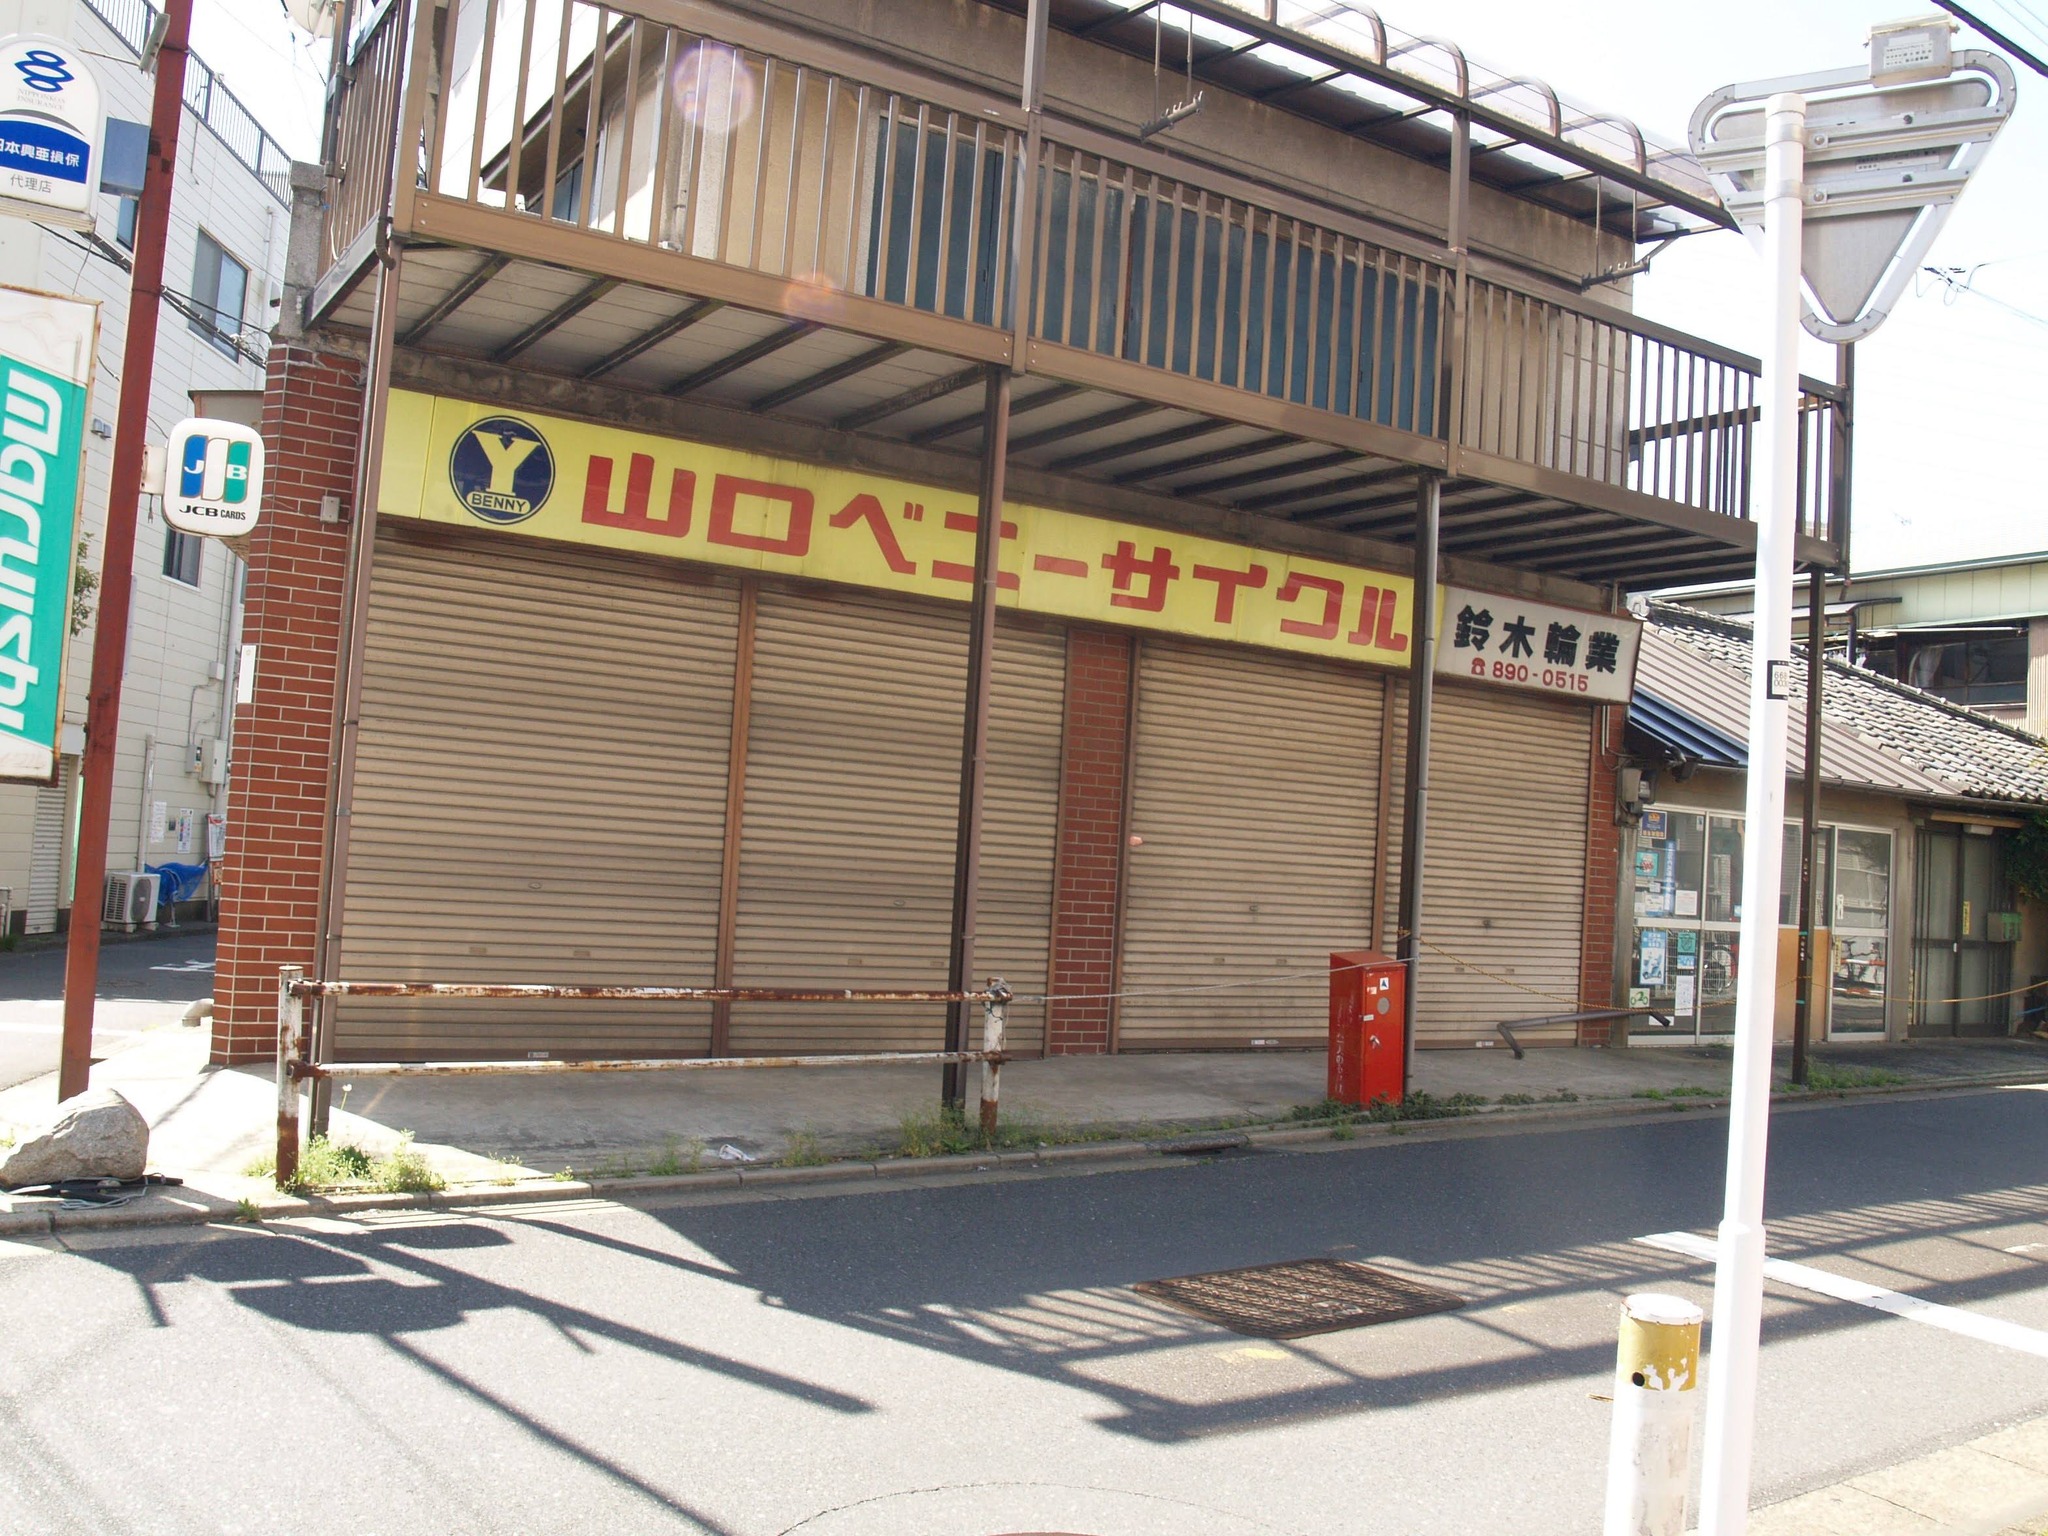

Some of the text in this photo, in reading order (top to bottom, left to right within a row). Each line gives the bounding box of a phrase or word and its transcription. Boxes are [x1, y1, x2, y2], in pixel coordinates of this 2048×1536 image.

[10, 173, 53, 194] 代理店
[179, 505, 246, 520] JCB CARDS
[471, 494, 527, 512] BENNY
[1453, 604, 1621, 675] 鈴木輪業
